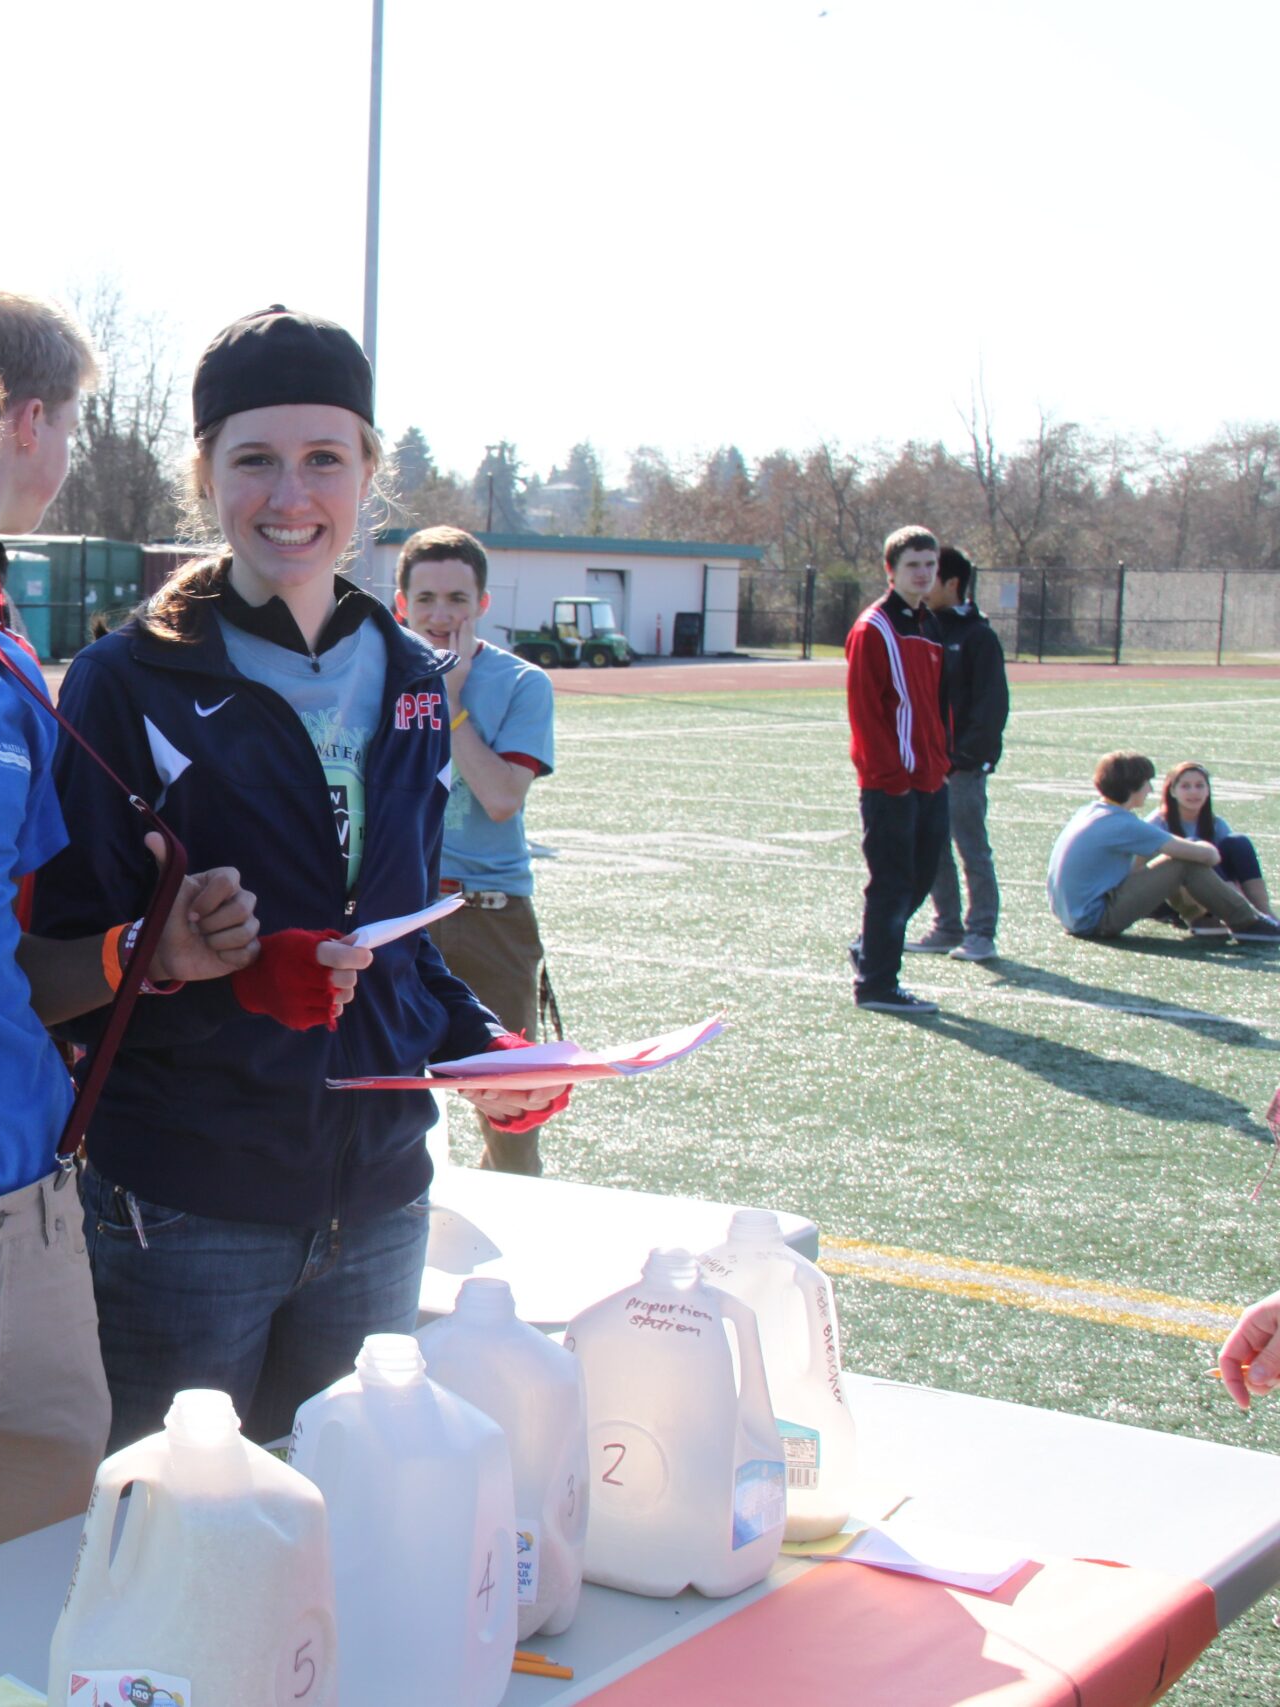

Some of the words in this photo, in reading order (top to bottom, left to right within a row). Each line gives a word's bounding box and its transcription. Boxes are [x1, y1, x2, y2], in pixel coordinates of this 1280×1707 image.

[602, 1442, 627, 1486] 2
[567, 1474, 576, 1518] 3
[477, 1550, 496, 1613] 4
[294, 1637, 316, 1699] 5
